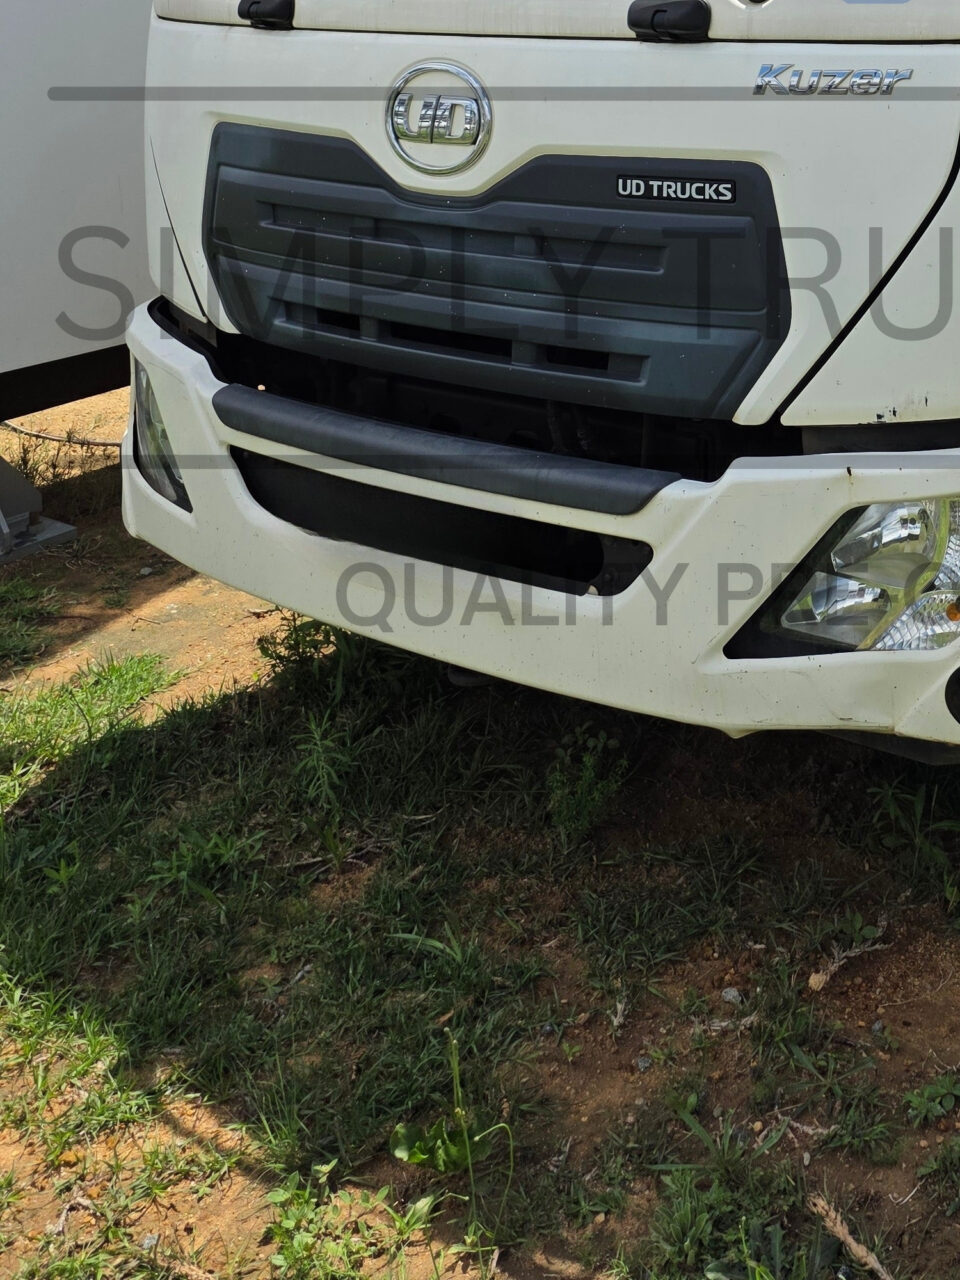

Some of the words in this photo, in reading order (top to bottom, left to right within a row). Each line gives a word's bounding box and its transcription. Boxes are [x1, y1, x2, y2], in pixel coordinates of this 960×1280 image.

[752, 63, 914, 96] Kuzer
[393, 92, 481, 146] UD
[618, 178, 645, 196] UD
[649, 180, 732, 200] TRUCKS
